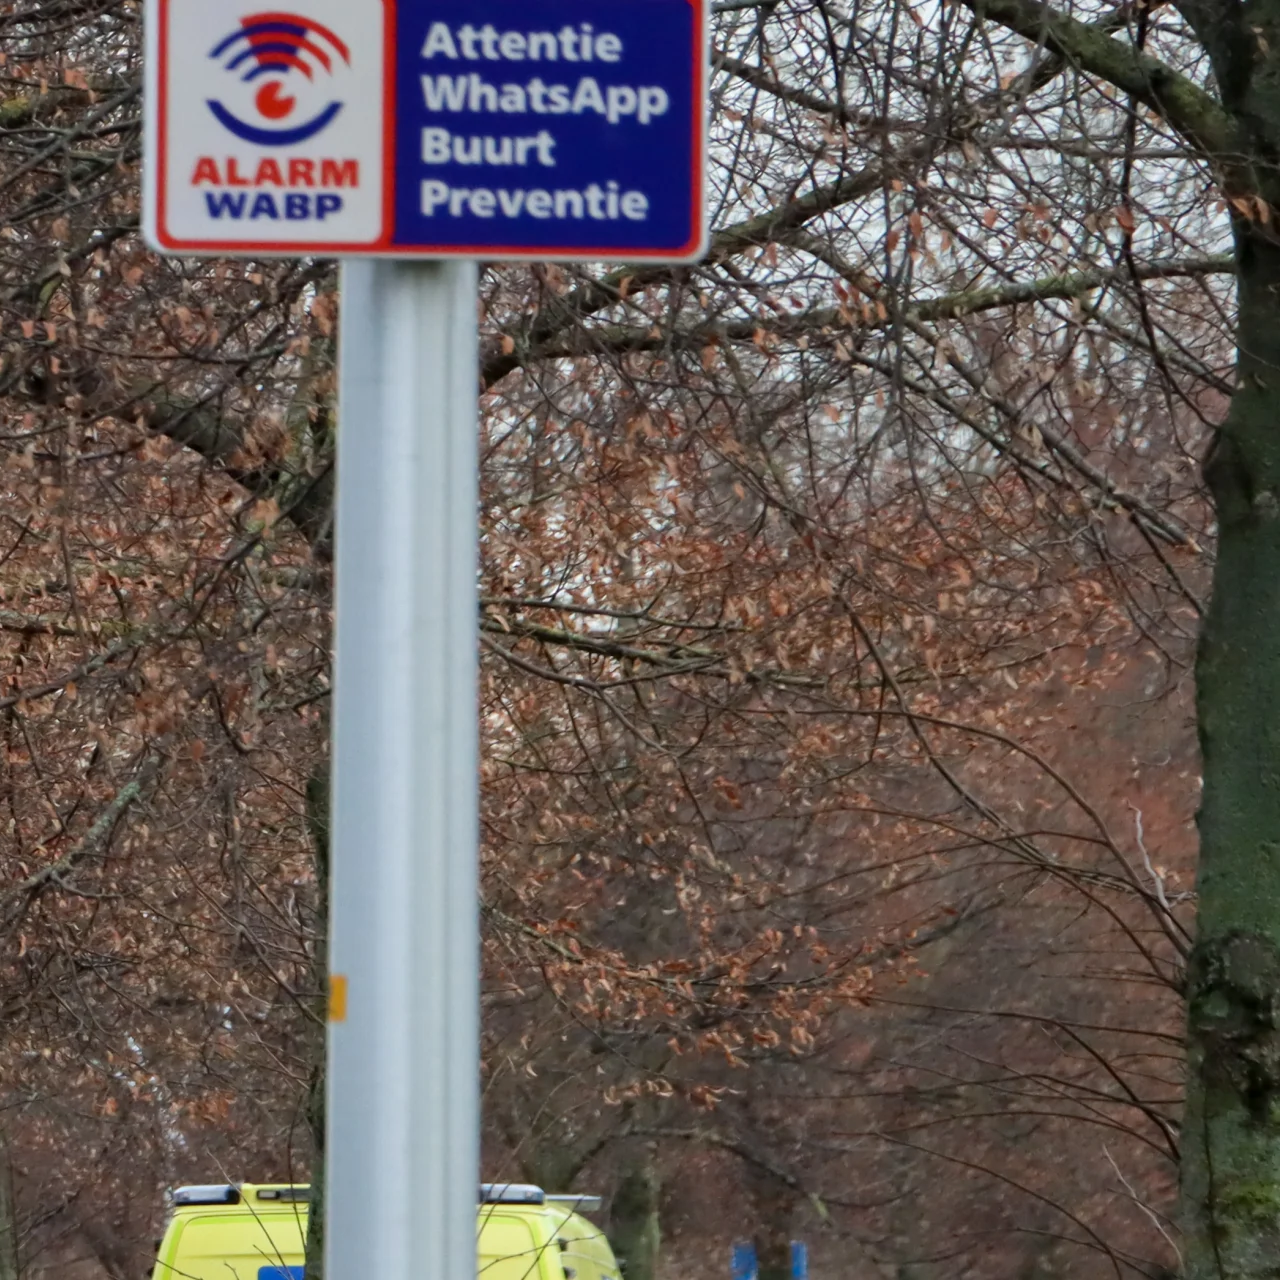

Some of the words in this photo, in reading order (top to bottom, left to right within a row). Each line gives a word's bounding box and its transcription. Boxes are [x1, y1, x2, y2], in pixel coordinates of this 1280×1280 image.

[421, 22, 623, 61] Attentie
[421, 74, 669, 122] WhatsApp
[421, 127, 556, 166] Buurt
[191, 158, 359, 189] ALARM
[205, 192, 344, 221] WABP
[420, 179, 648, 221] Preventie
